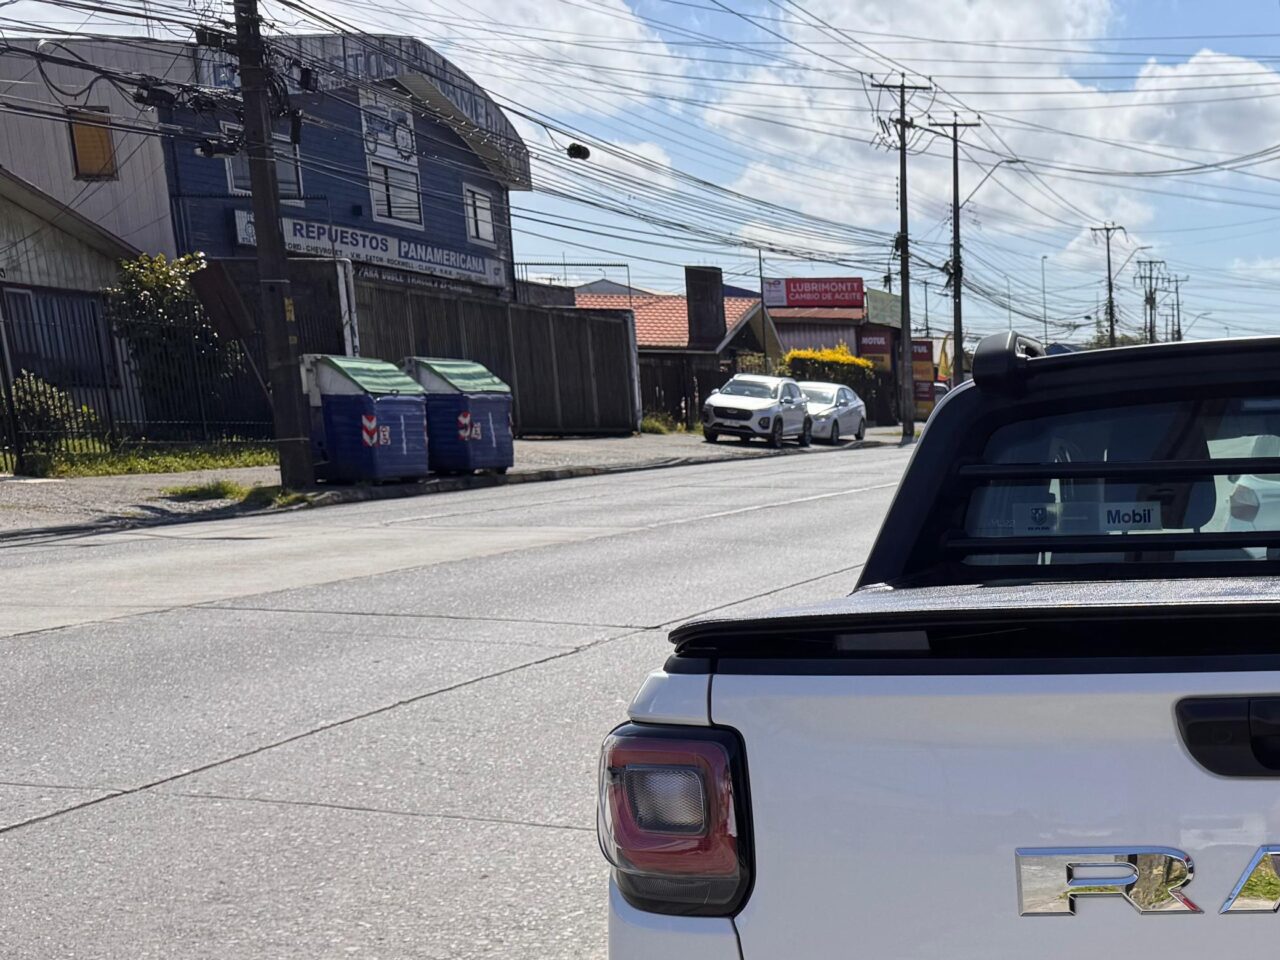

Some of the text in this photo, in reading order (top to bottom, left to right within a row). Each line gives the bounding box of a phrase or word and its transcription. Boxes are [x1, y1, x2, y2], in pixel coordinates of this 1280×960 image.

[292, 221, 485, 273] REPUESTOS PANAMERICANA
[790, 282, 858, 292] LUBRIMONTT
[789, 292, 862, 300] CAMBIO DE ACEITE
[862, 336, 886, 345] MOTUL
[1106, 508, 1151, 524] Mobil
